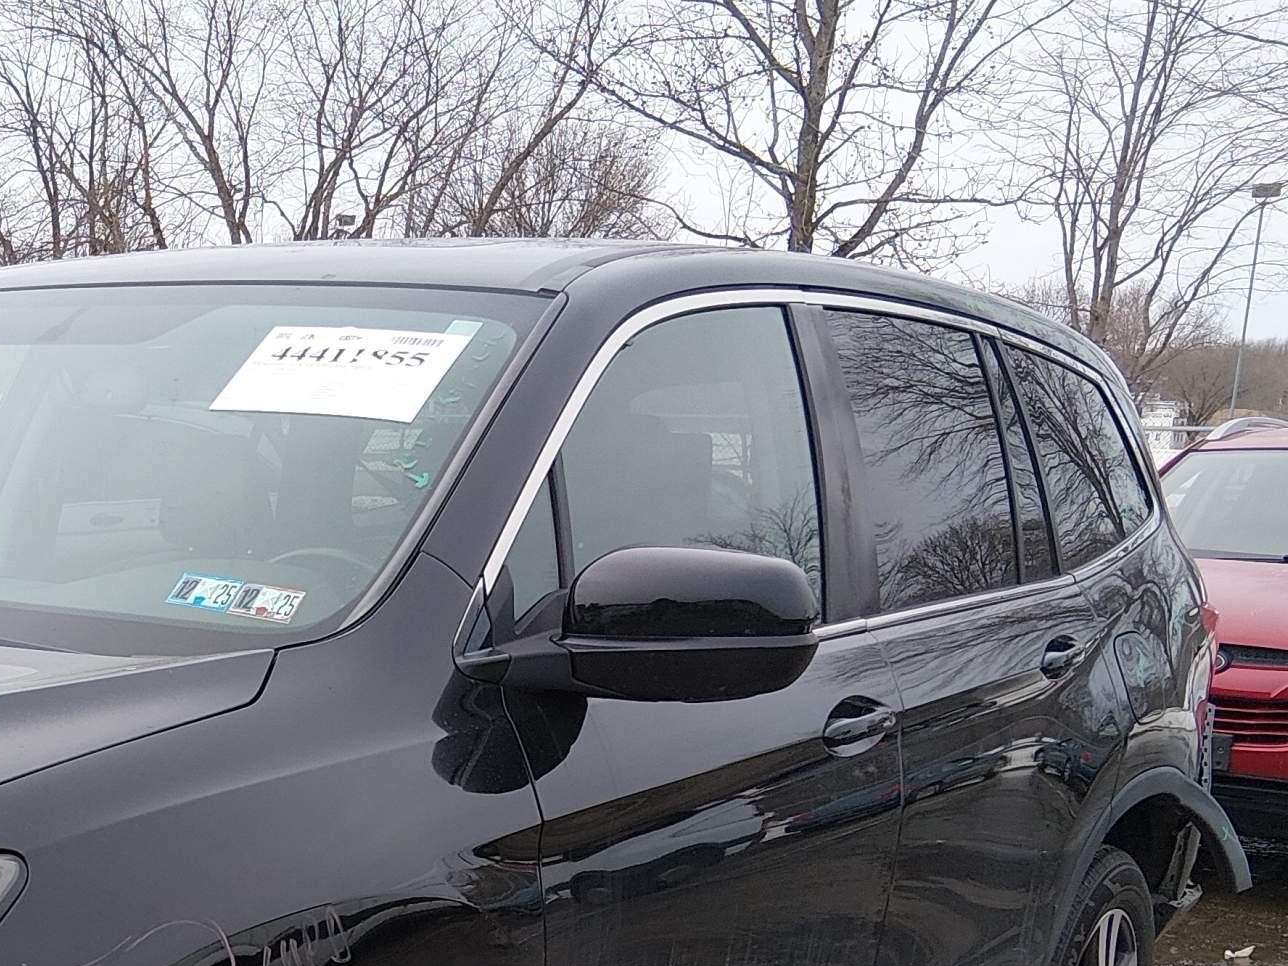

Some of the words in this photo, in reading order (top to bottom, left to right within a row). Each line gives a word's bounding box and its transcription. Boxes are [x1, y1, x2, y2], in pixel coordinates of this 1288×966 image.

[174, 578, 201, 600] 12
[213, 585, 238, 606] 25
[234, 588, 261, 612] 12
[276, 595, 300, 617] 25
